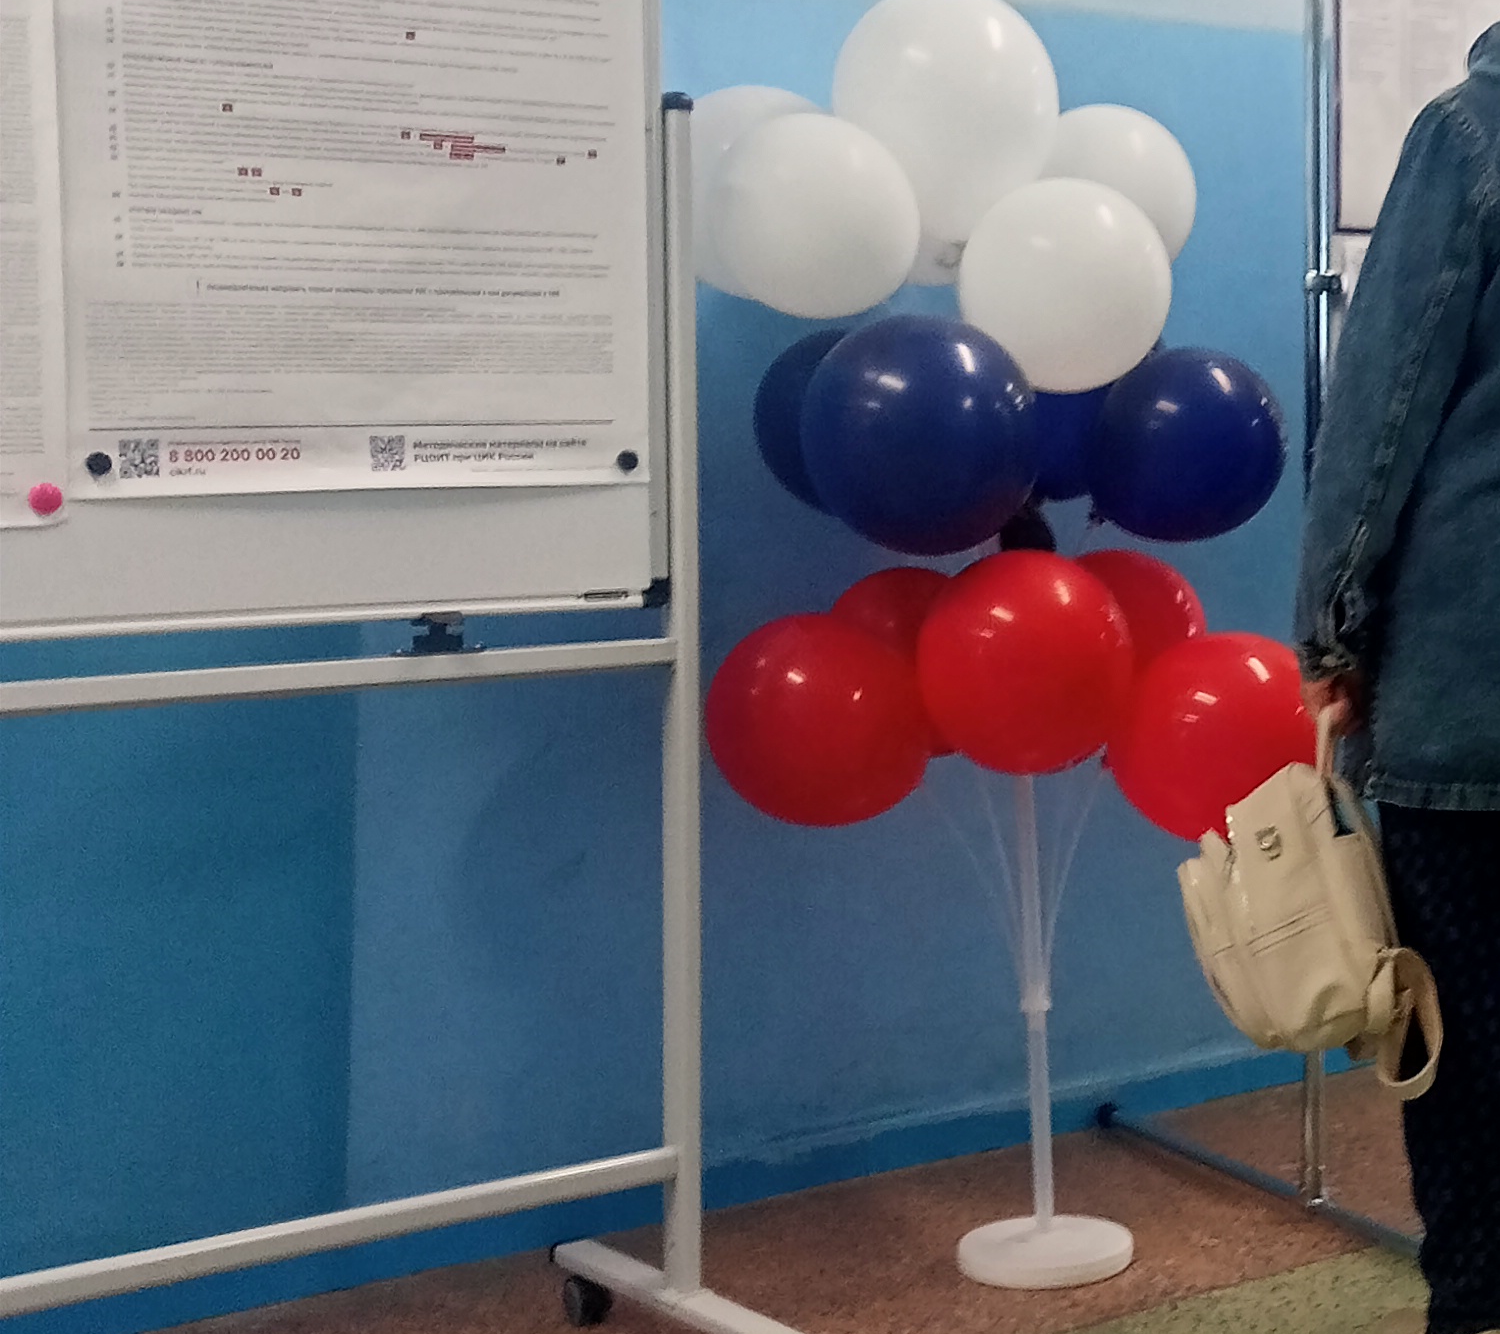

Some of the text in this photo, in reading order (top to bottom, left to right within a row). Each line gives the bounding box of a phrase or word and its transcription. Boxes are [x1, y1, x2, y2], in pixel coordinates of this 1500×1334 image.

[169, 447, 301, 463] 8 800 200 00 20
